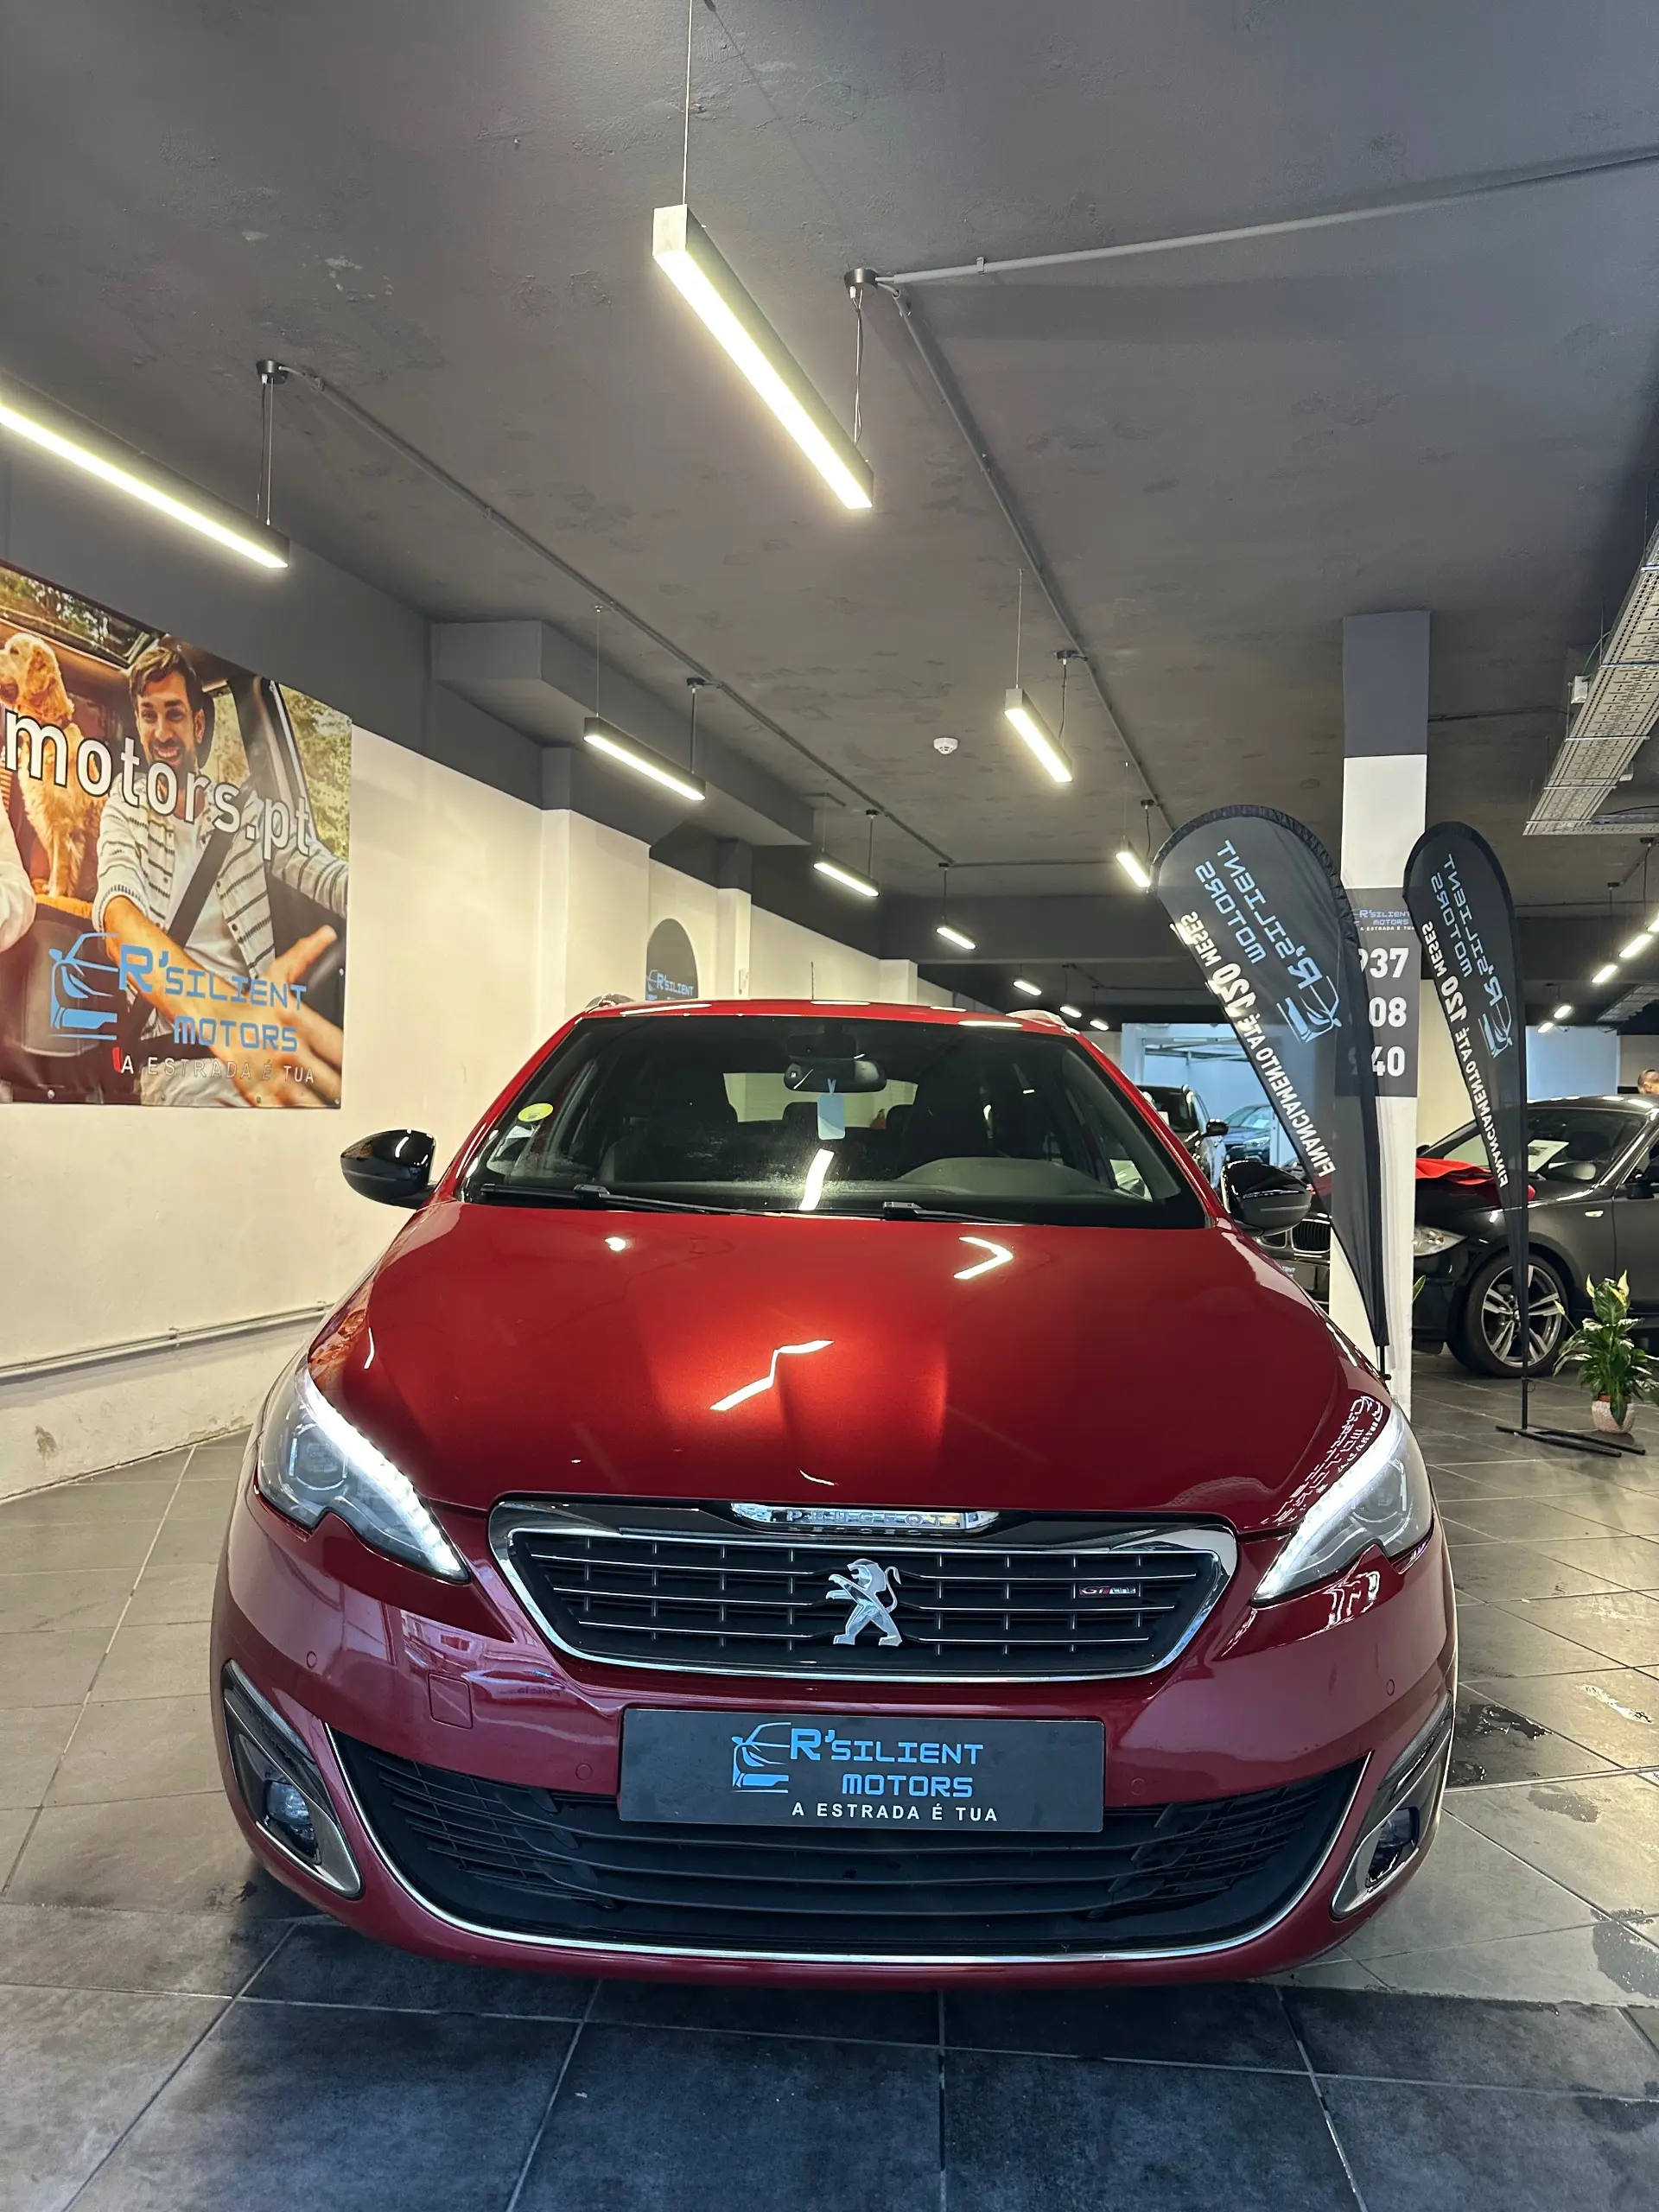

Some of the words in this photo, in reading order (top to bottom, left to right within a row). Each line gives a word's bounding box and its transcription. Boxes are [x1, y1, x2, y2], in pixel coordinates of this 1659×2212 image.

[4, 709, 311, 861] motors.pt
[1368, 996, 1408, 1027] 08
[174, 1015, 299, 1052] MOTORS
[120, 1054, 135, 1074] A
[148, 1056, 252, 1080] ESTRADA
[263, 1059, 272, 1081] É
[283, 1065, 315, 1083] TUA
[1371, 1046, 1406, 1077] 40
[790, 1727, 984, 1764] R'SILIENT
[842, 1773, 973, 1797] MOTORS
[791, 1802, 804, 1816] A
[817, 1802, 920, 1820] ESTRADA
[931, 1803, 944, 1821] É
[956, 1807, 998, 1821] TUA
